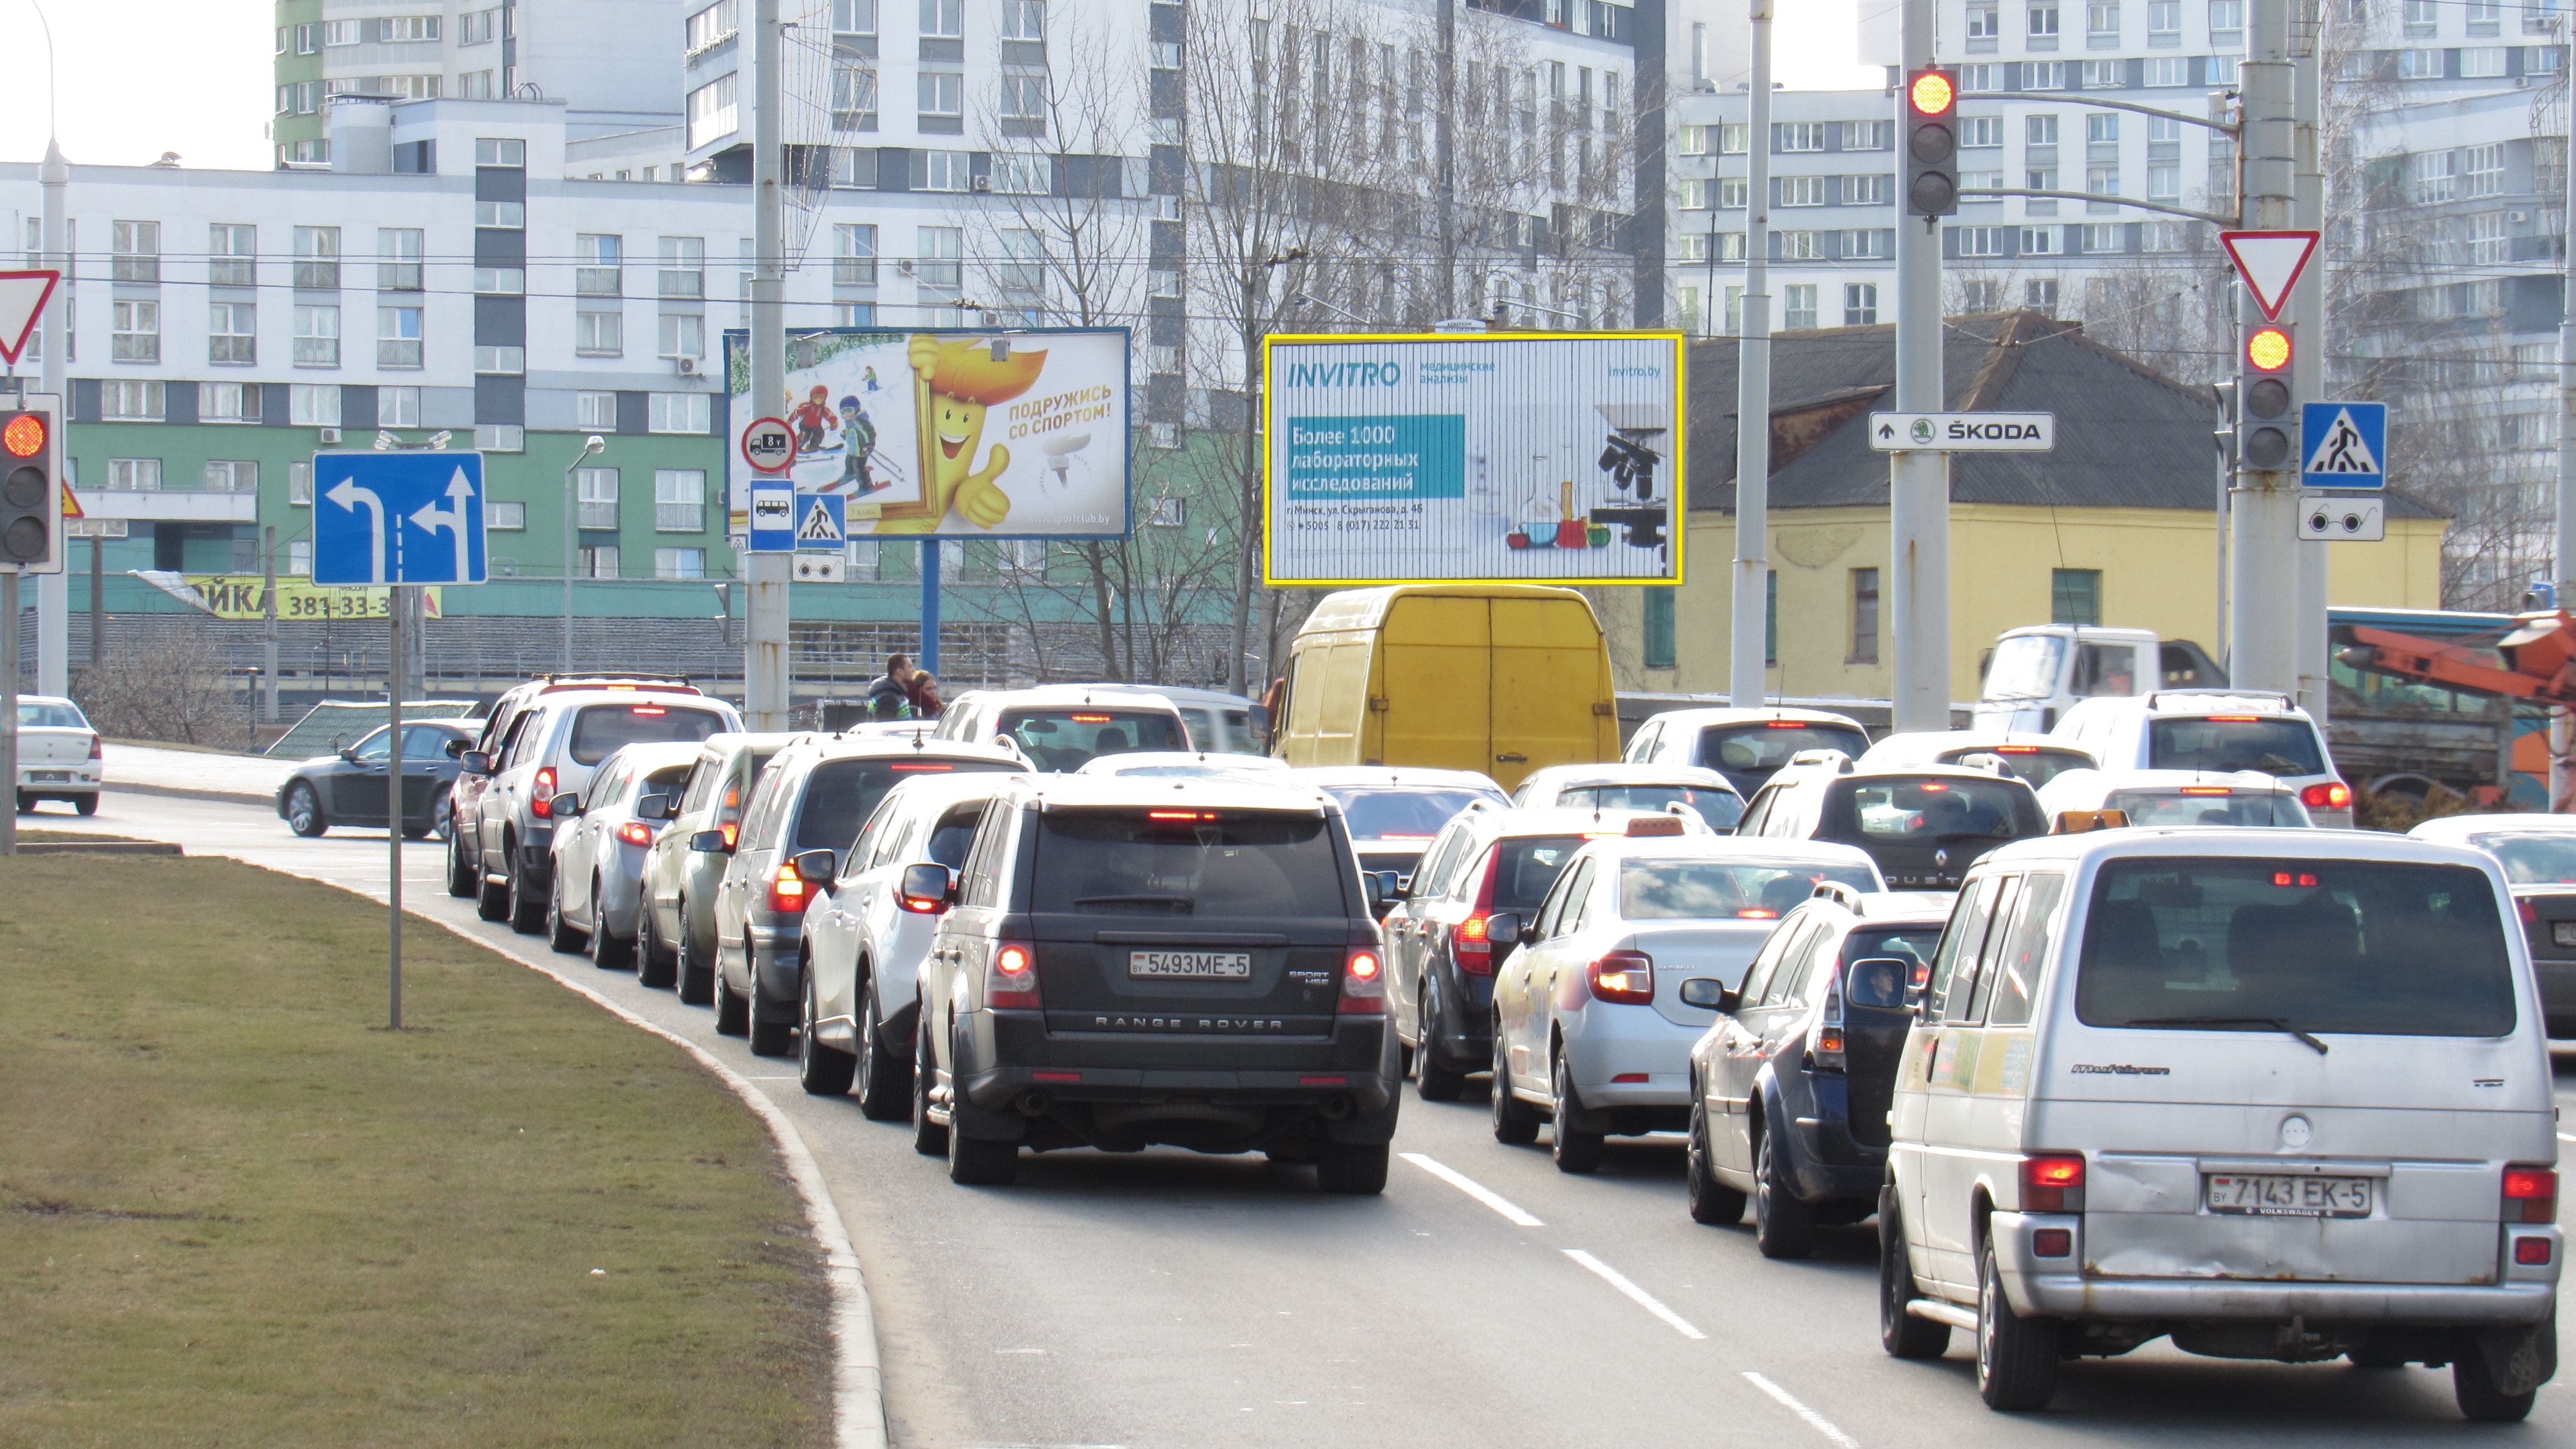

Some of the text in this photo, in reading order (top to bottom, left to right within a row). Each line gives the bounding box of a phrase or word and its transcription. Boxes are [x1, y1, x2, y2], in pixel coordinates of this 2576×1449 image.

[1287, 361, 1401, 387] INVITRO
[1420, 363, 1495, 372] медицинские
[1609, 365, 1660, 378] invitro.by
[1420, 375, 1468, 383] анализы
[1009, 383, 1111, 422] ПОДРУЖИСЬ
[1009, 402, 1111, 440] СО СПОРТОМ!
[1292, 426, 1395, 445] Более 1000
[1948, 420, 2041, 439] ŠKODA
[1292, 451, 1419, 472] лабораторных
[1292, 472, 1414, 493] исследований
[1295, 505, 1325, 516] Минск,
[1327, 507, 1339, 516] ул.
[1342, 504, 1399, 516] Скрыганова,
[1337, 520, 1343, 530] 8
[1346, 520, 1370, 532] (017)
[1374, 520, 1390, 529] 222
[1394, 519, 1404, 529] 21
[1408, 520, 1419, 529] 31
[290, 596, 391, 615] 381-33-3
[1886, 876, 1959, 885] DUST
[1132, 965, 1143, 973] BY
[1096, 1016, 1282, 1029] RANGE ROVER
[2213, 1192, 2227, 1202] BY
[2260, 1208, 2319, 1216] VOLKSWAGEN
